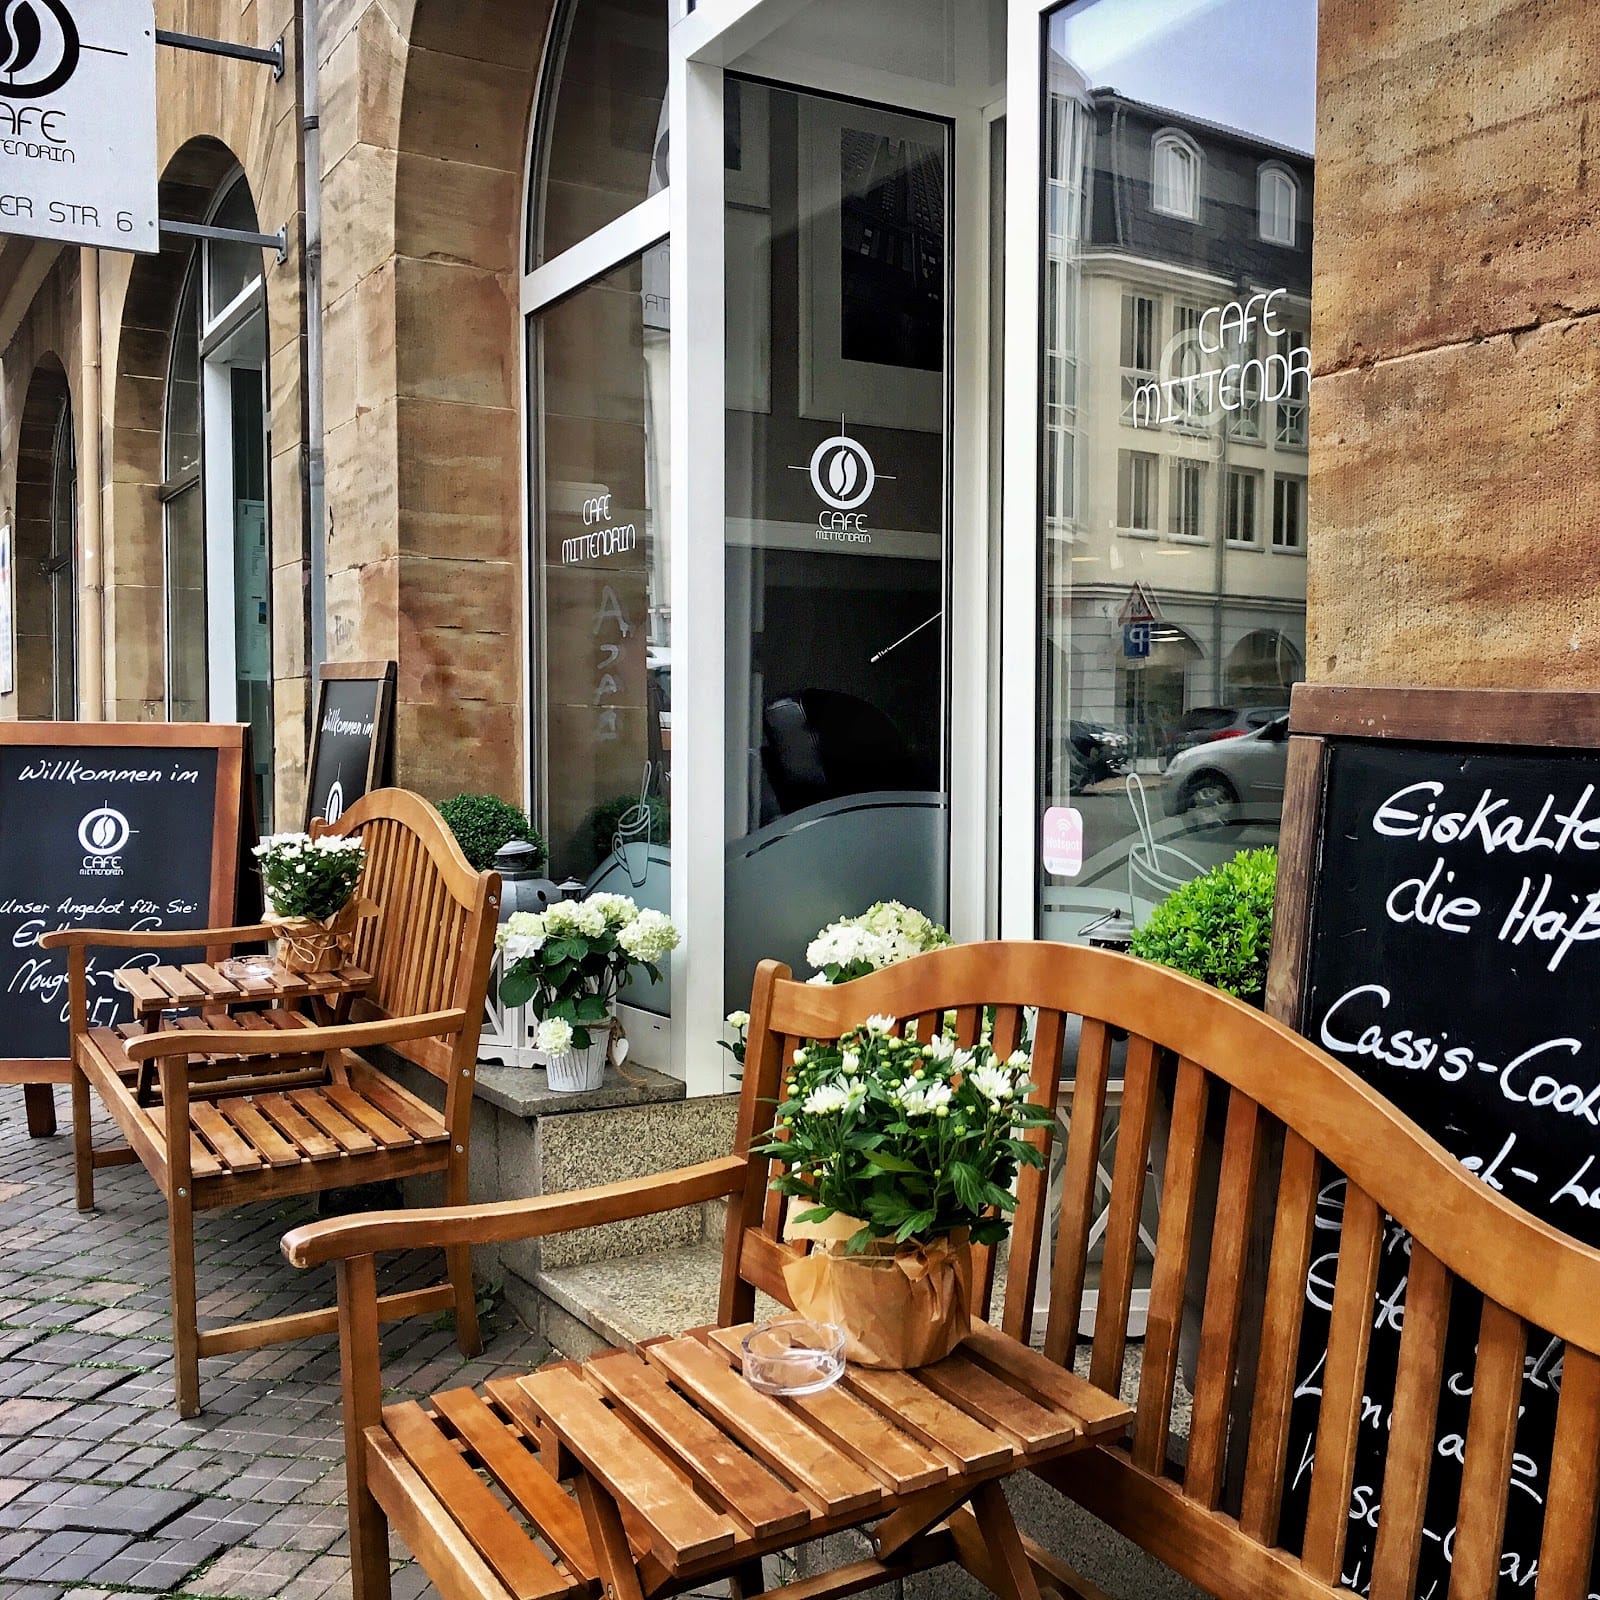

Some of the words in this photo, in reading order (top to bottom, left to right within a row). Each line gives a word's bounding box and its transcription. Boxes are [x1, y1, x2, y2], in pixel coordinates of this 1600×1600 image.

[0, 101, 67, 143] AFE
[0, 194, 33, 218] ER
[49, 201, 101, 228] STR.
[116, 211, 133, 232] 6
[1198, 287, 1287, 354] CAFE
[1133, 346, 1311, 429] MITTENDR
[582, 494, 612, 526] CAFE
[818, 510, 869, 533] CAFE
[561, 523, 637, 564] MITTENDRIN
[815, 529, 872, 544] MITTENDRIN
[321, 707, 361, 737] Willkommen
[18, 759, 162, 784] Willkommen
[170, 763, 200, 784] im
[82, 855, 122, 869] CAFE
[0, 898, 50, 914] Unser
[57, 896, 125, 921] Angebot
[129, 899, 161, 915] für
[166, 898, 199, 914] Sie:
[1386, 857, 1482, 935] die
